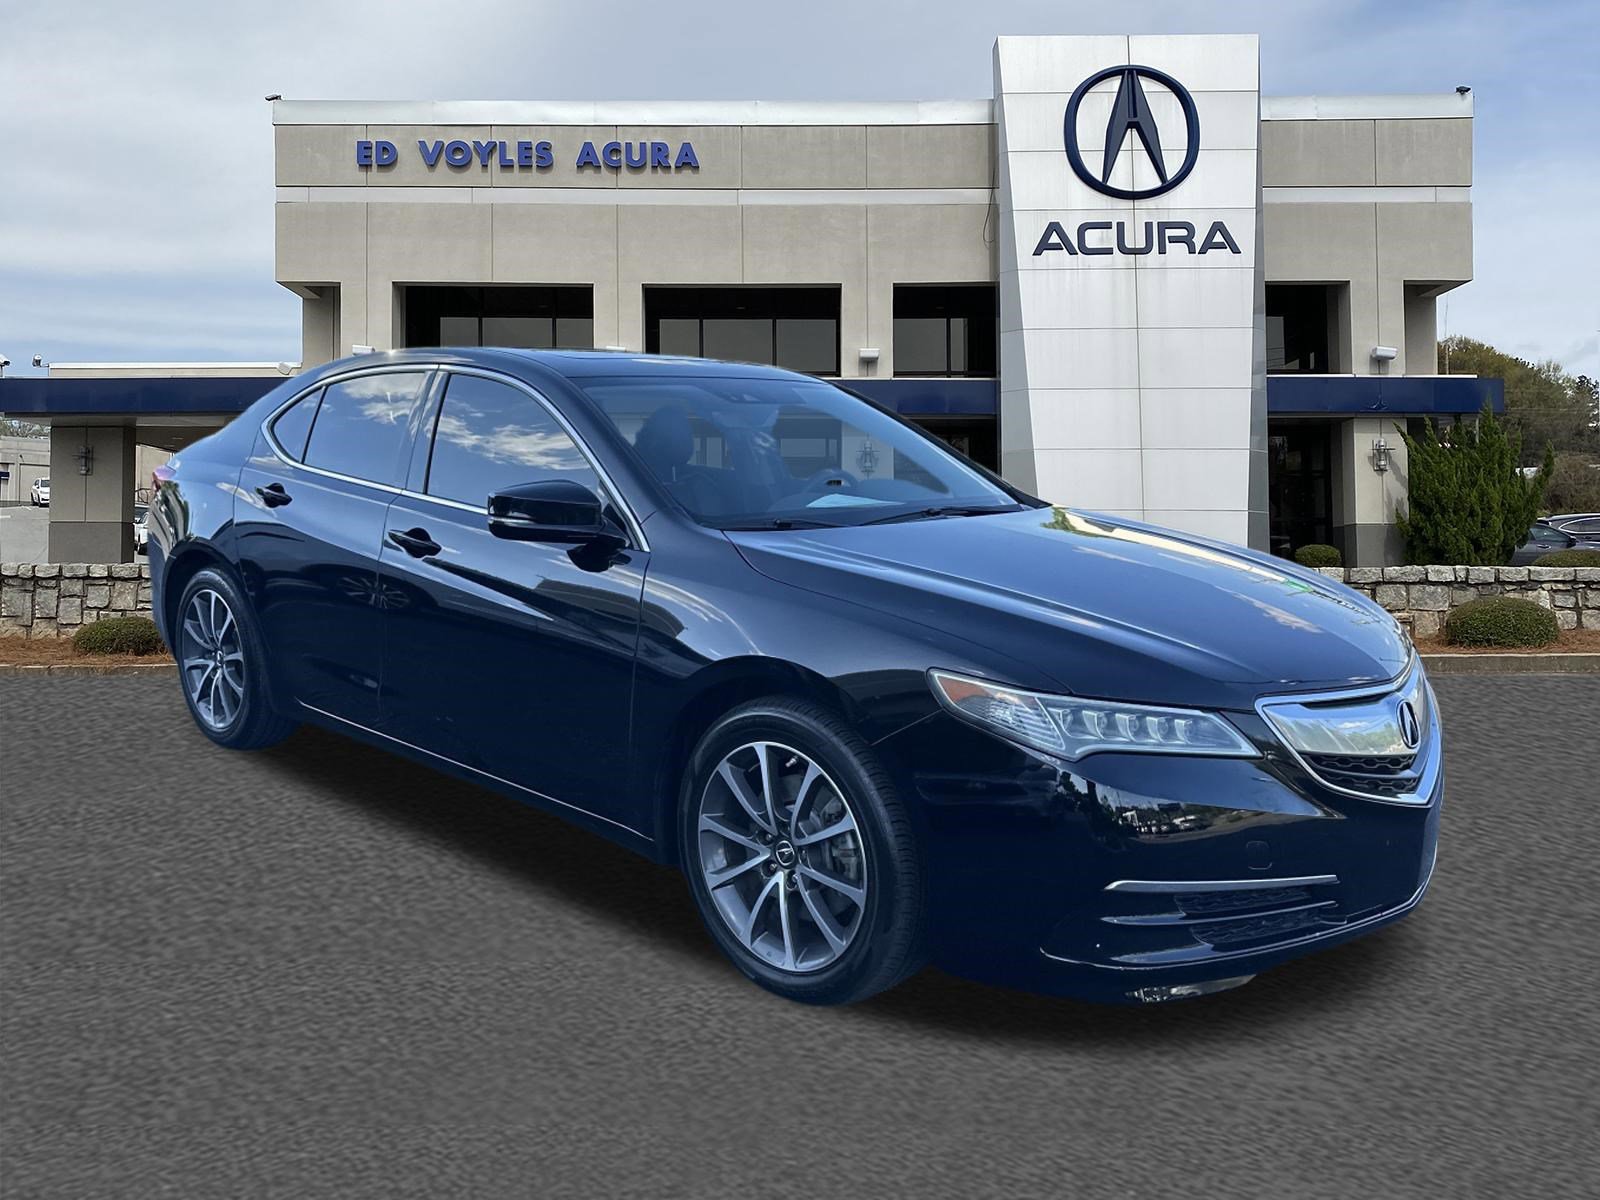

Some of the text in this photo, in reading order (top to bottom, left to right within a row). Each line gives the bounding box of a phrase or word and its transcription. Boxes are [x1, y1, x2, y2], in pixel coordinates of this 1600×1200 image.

[356, 140, 700, 169] ED VOYLES ACURA
[1032, 221, 1242, 256] ACURA
